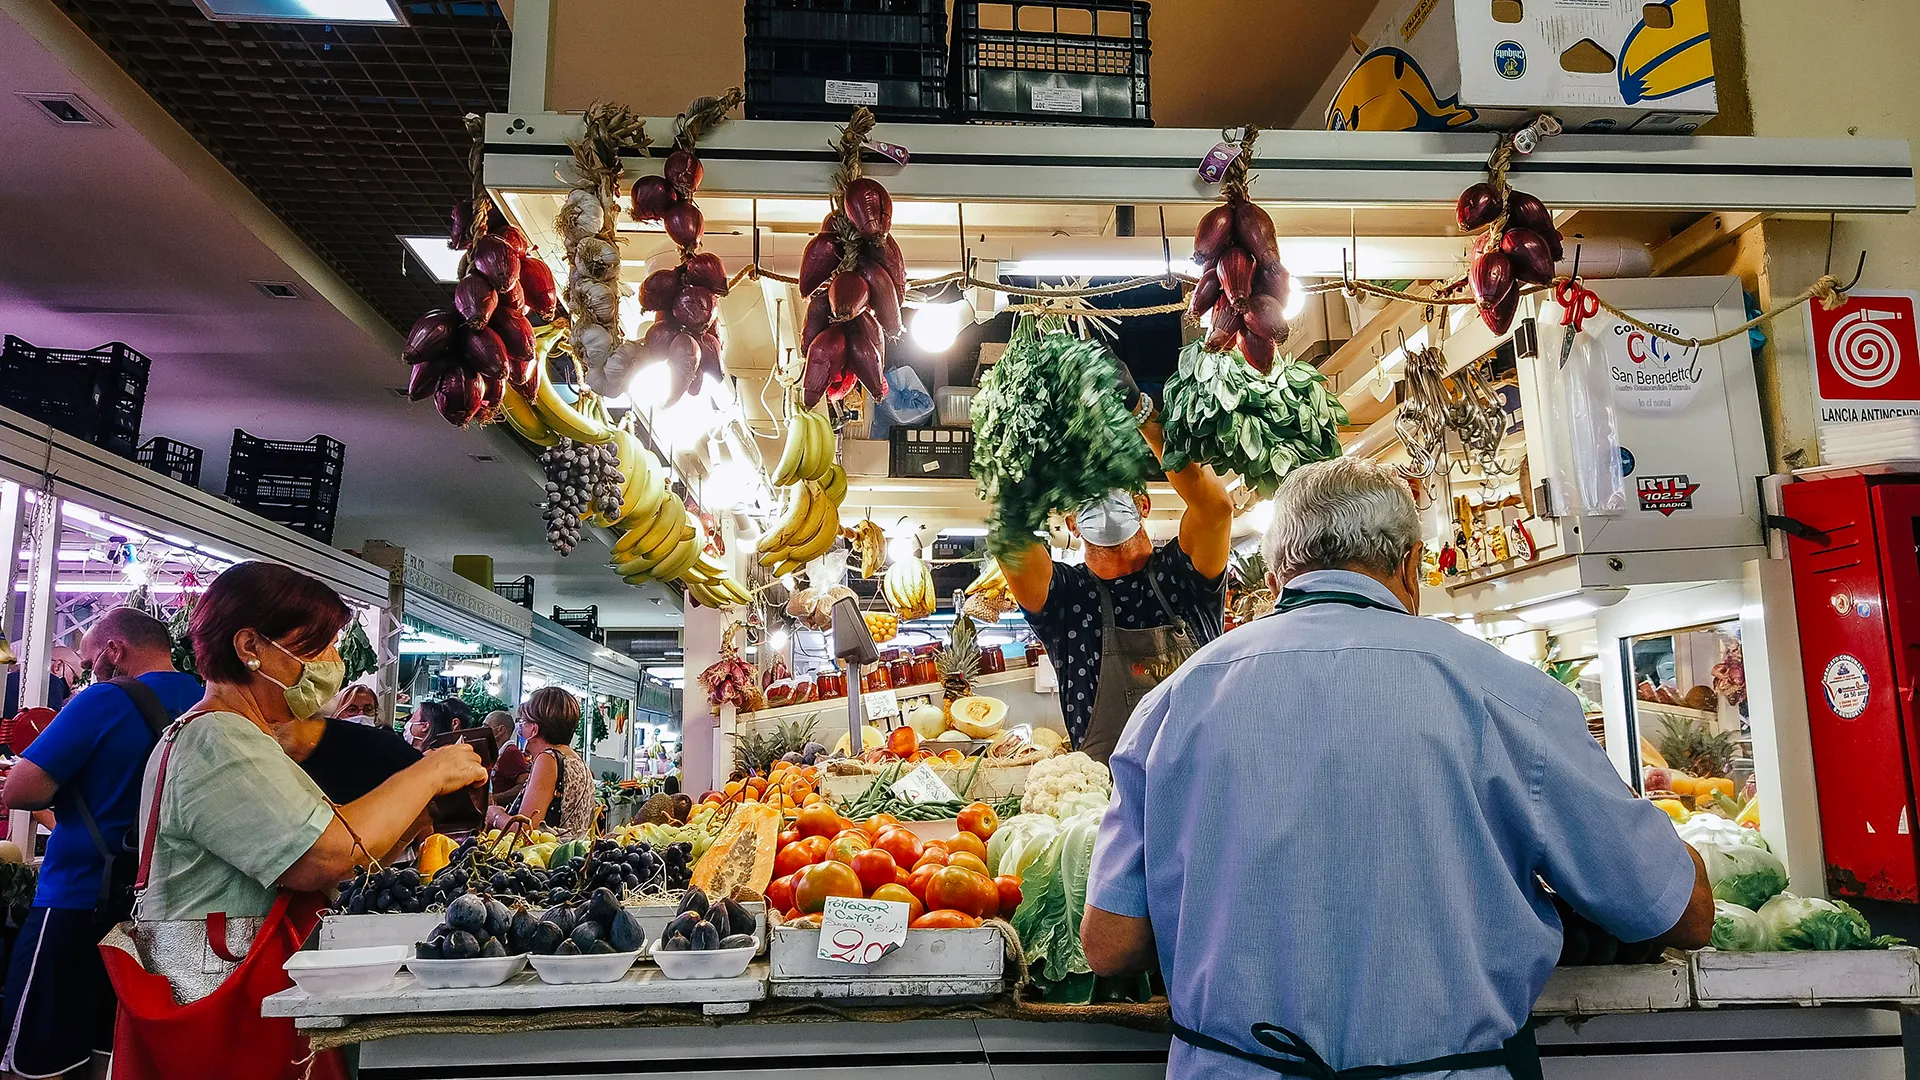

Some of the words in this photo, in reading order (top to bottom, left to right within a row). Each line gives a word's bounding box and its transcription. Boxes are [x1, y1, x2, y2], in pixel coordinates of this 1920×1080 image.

[1495, 47, 1525, 59] Chiquita
[1611, 366, 1634, 384] San
[1822, 408, 1858, 422] LANCIA
[1860, 408, 1920, 422] ANTINCENDI
[1638, 477, 1687, 491] RTL
[1644, 491, 1684, 501] 102.5
